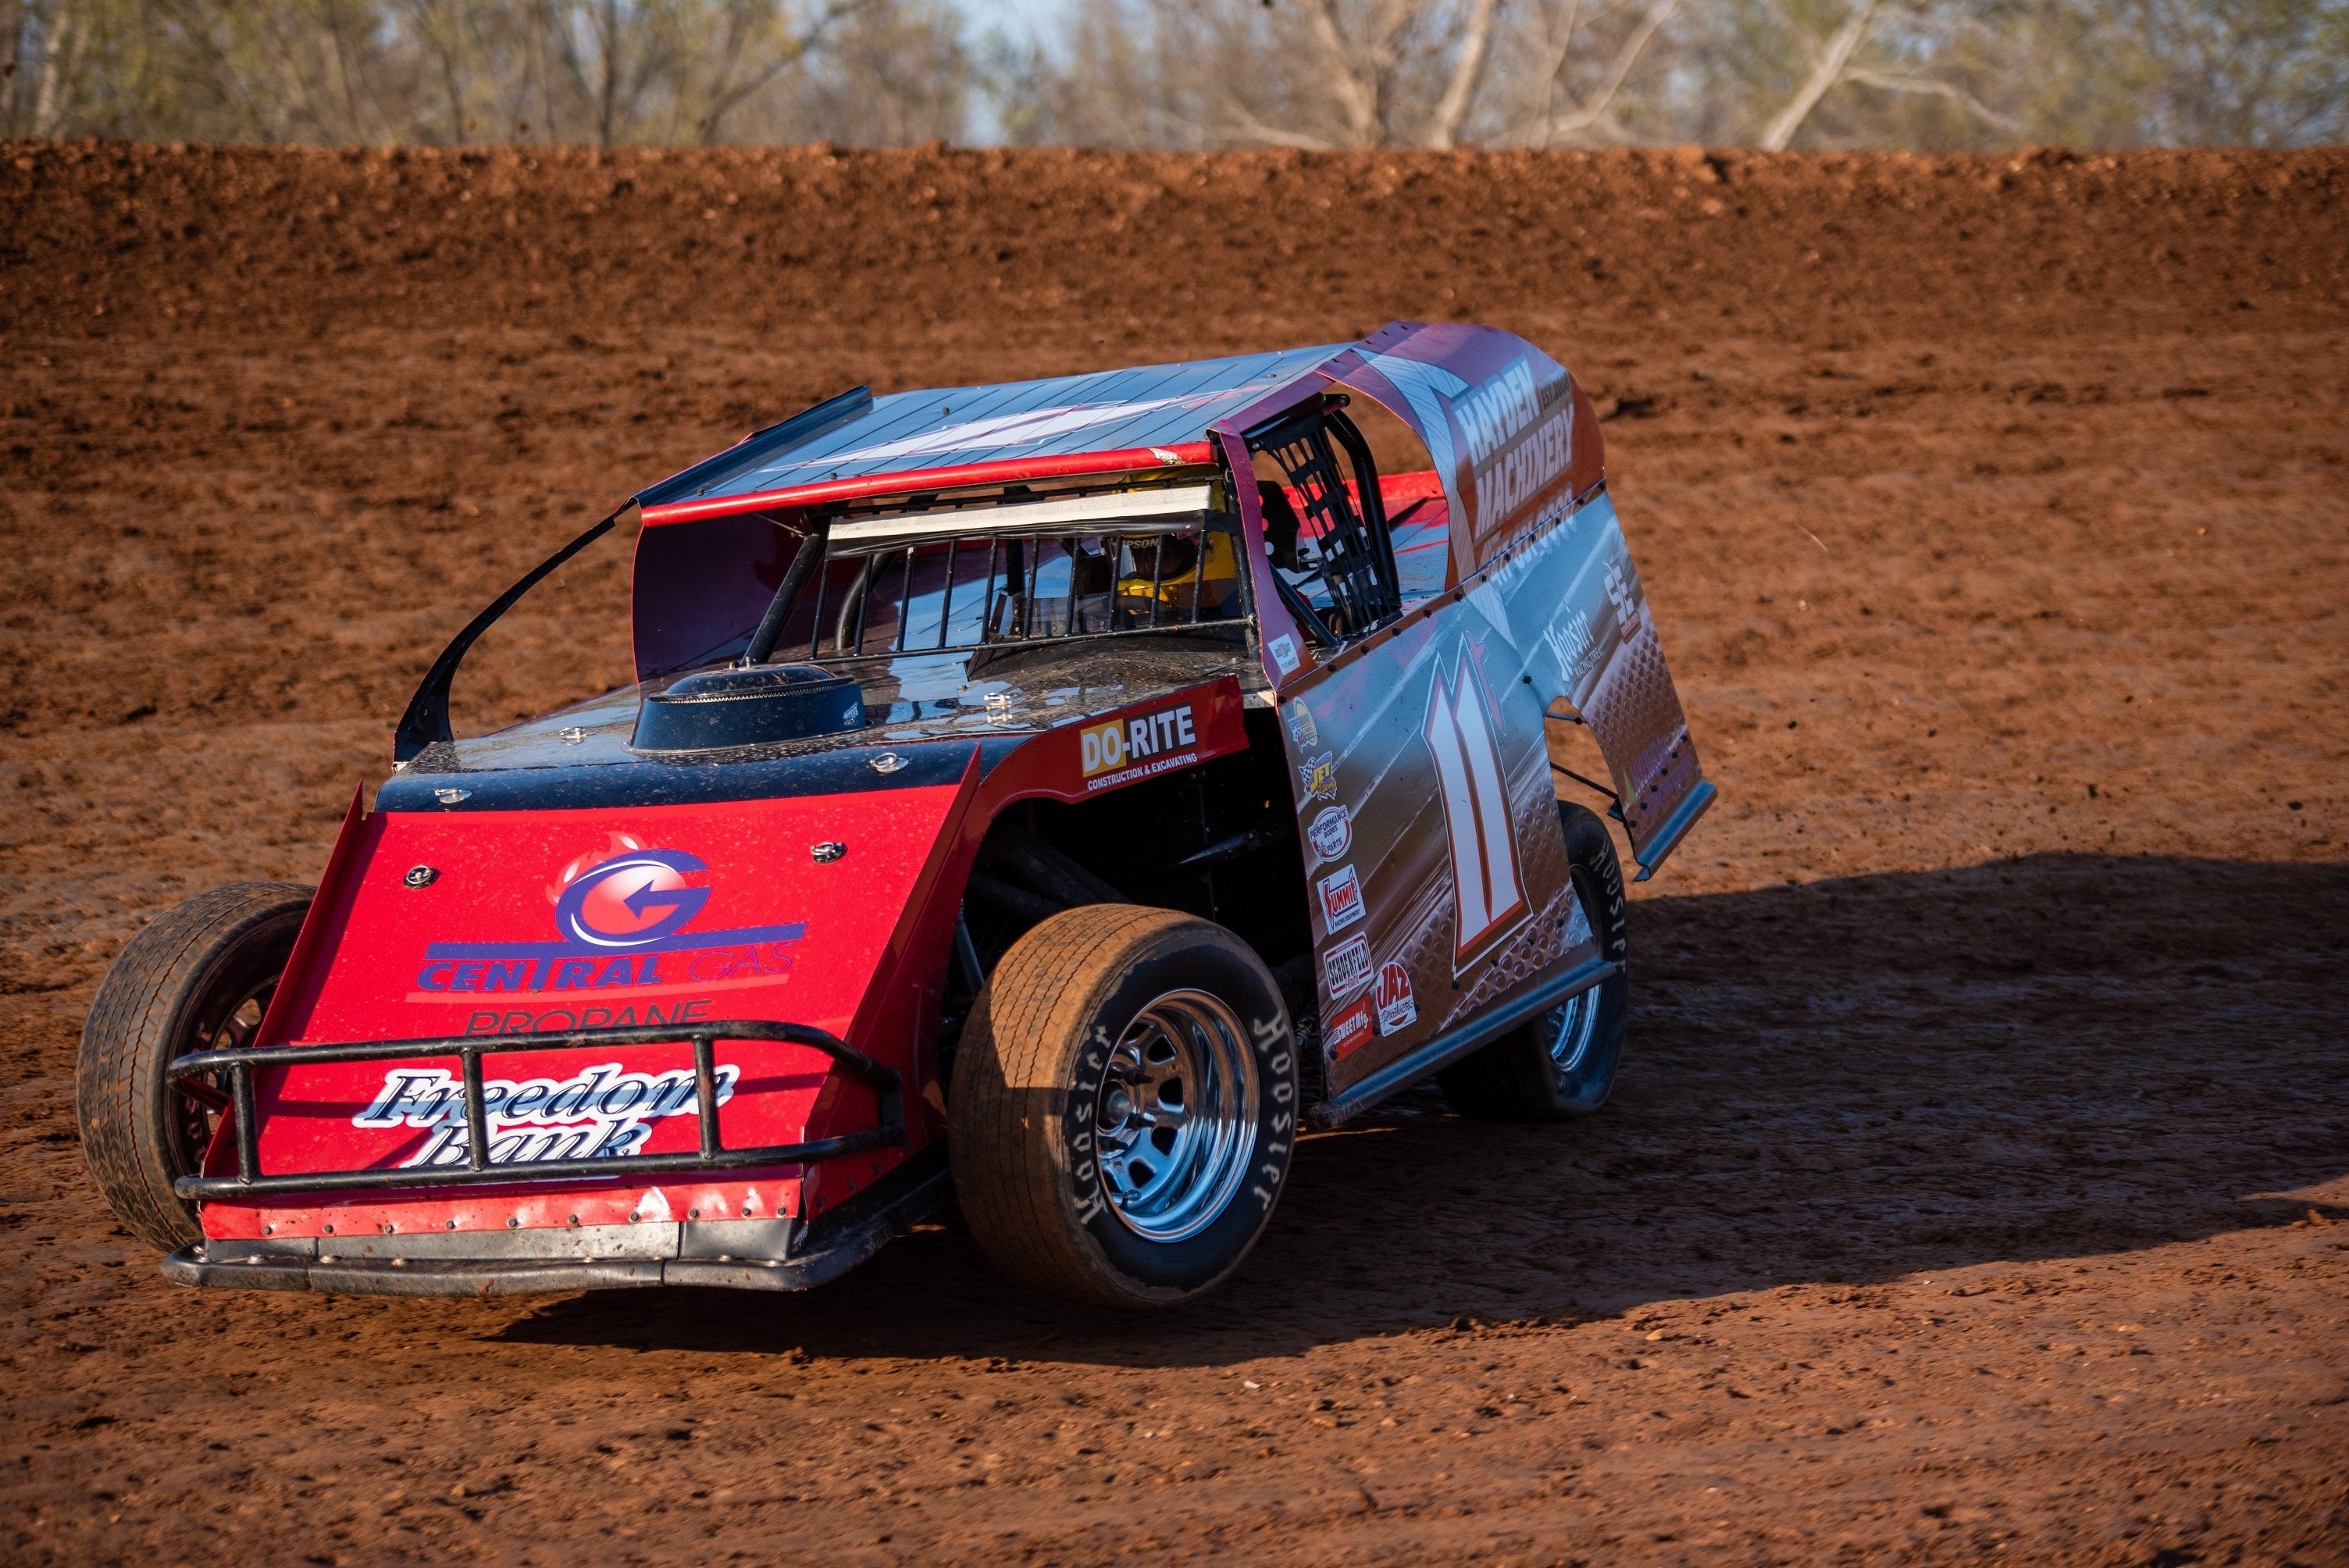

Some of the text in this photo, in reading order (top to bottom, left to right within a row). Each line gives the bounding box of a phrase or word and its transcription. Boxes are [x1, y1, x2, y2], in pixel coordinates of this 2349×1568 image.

[1454, 359, 1540, 466] HAYDEN
[1474, 404, 1574, 540] MACHINERY
[1574, 647, 1601, 679] RACING TIRE
[1082, 706, 1196, 772] DO-RITE
[1088, 753, 1197, 790] CONSTRUCTION & EXCAVATING
[1310, 761, 1331, 793] JET
[1310, 809, 1347, 839] PERFORMANCE
[1423, 640, 1531, 972] 11
[1324, 825, 1338, 839] BODIES
[1327, 837, 1342, 853] PARTS
[1323, 876, 1359, 921] SUMMIT
[1335, 908, 1360, 927] RACING EQUIPMENT
[416, 943, 793, 993] CENTRAL GAS
[1328, 943, 1369, 986] SCHOENFELD
[1377, 964, 1411, 1010] JAZ
[464, 1000, 712, 1036] PROPANE
[1333, 1016, 1356, 1045] SWEET
[362, 1067, 733, 1122] Freedom
